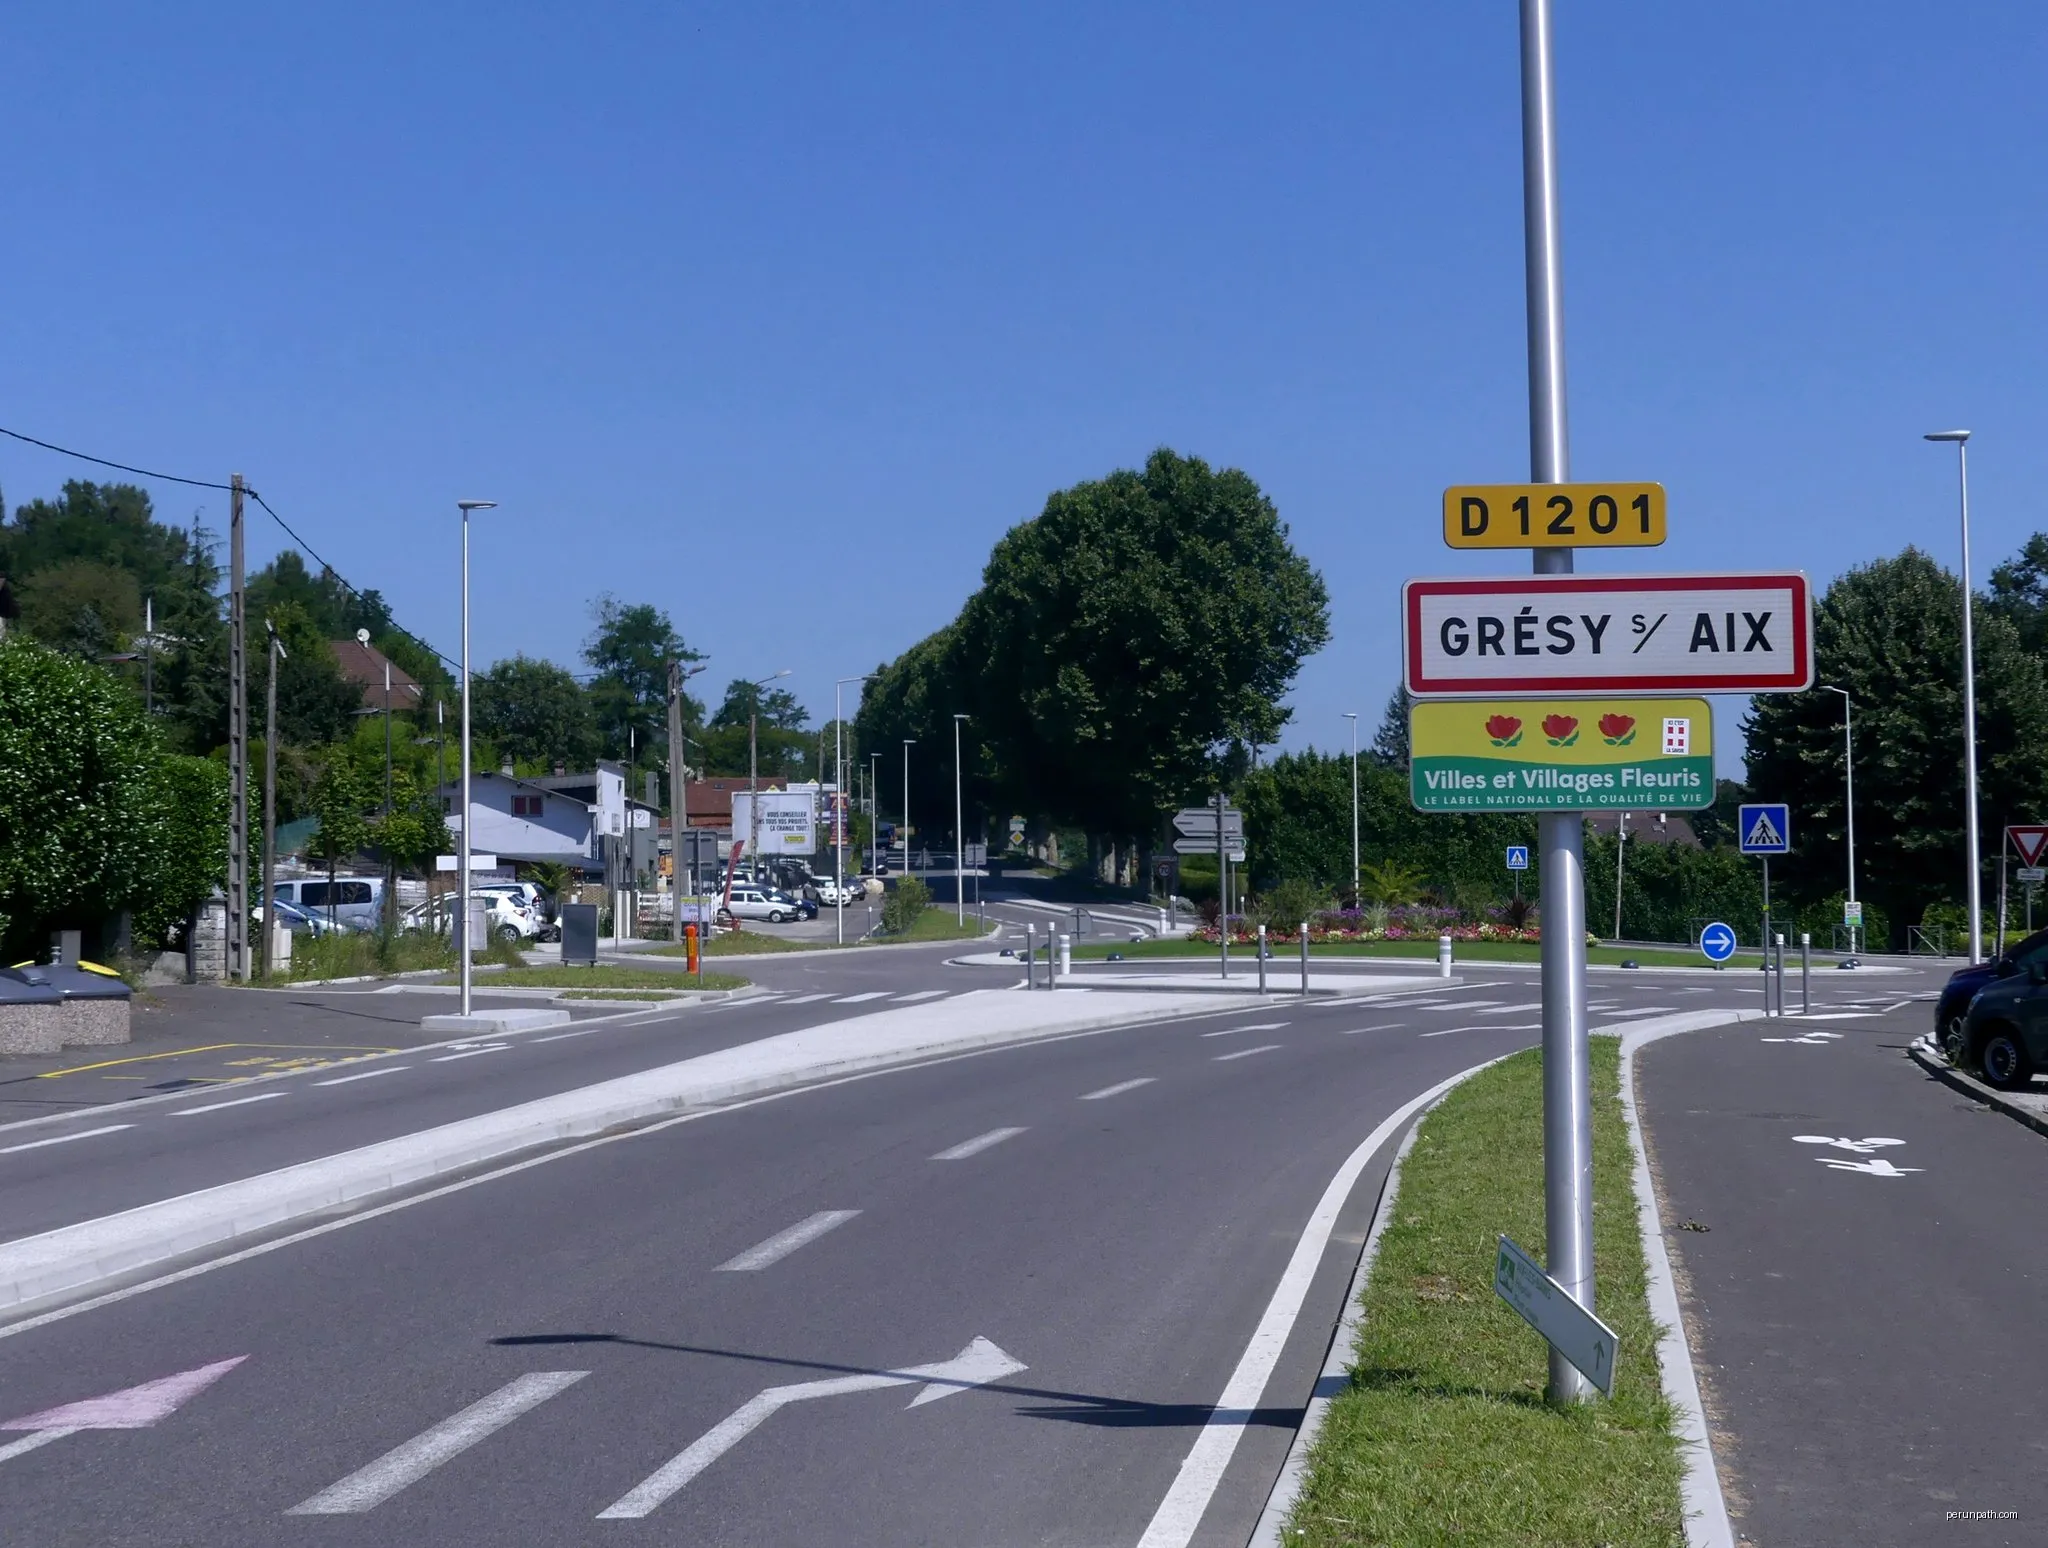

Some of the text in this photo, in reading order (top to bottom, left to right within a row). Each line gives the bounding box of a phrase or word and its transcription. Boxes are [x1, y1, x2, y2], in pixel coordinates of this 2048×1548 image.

[1460, 494, 1650, 536] D 1201
[1440, 606, 1611, 656] GRÉSY
[1689, 612, 1773, 653] AIX
[1424, 767, 1701, 793] Villes et Villages Fleuris
[1424, 791, 1703, 805] LE LABEL NATIONAL DE LA QUALITÉ DE VIE
